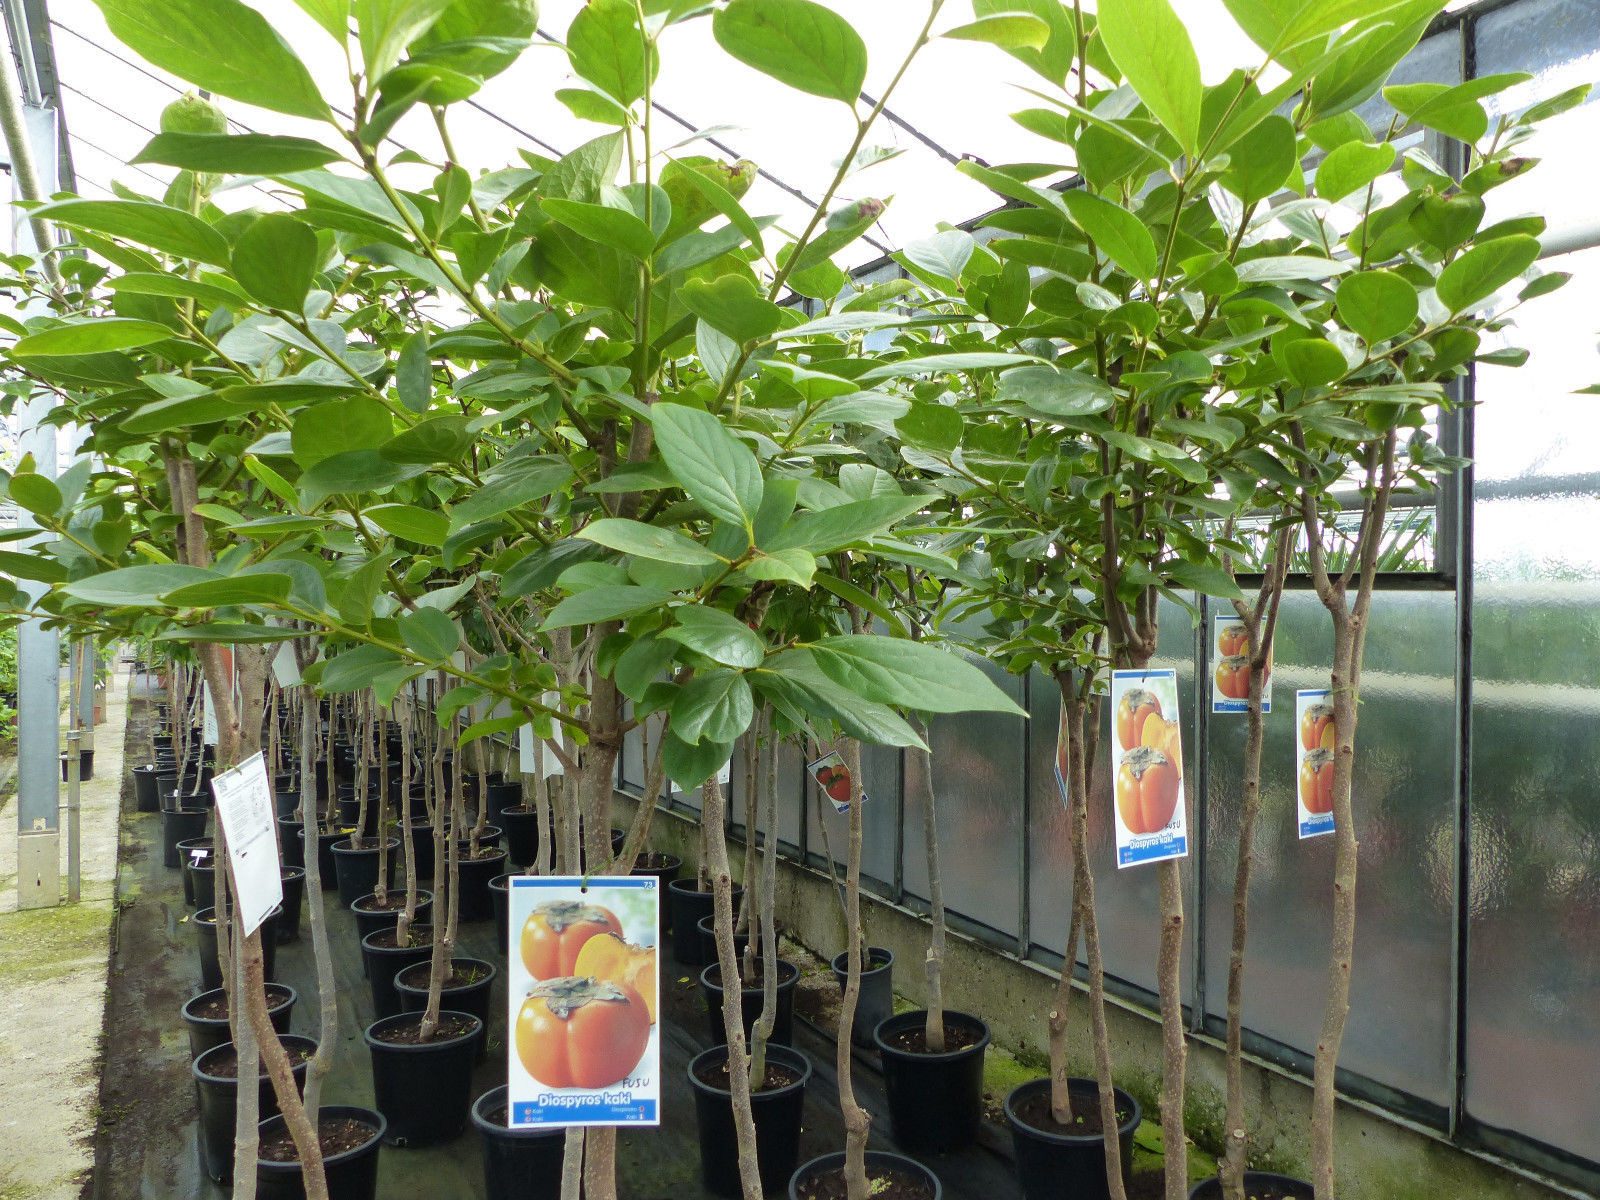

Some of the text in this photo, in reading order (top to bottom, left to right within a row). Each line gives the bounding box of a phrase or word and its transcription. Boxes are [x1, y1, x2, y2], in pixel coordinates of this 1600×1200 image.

[1129, 832, 1174, 850] Diospyros kaki
[538, 1091, 632, 1108] Diospyros kaki
